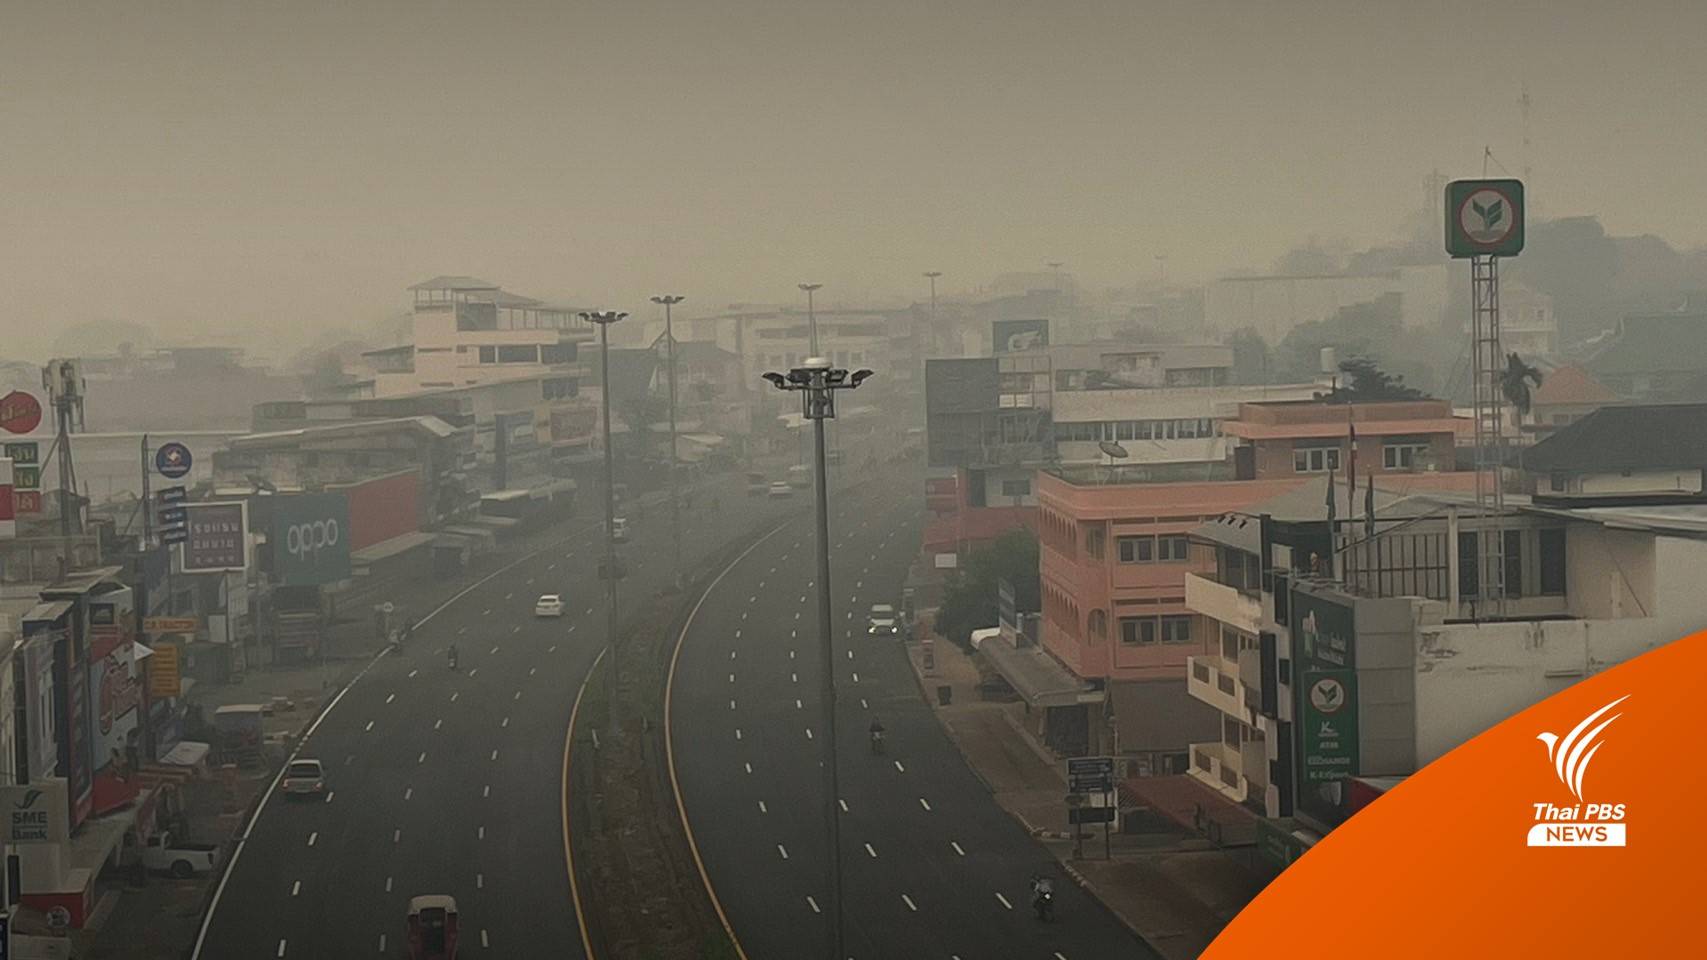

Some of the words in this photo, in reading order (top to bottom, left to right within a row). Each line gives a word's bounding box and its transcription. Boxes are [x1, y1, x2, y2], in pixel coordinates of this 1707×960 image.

[287, 519, 339, 562] oppo
[12, 811, 47, 824] SME
[12, 828, 48, 841] Bank
